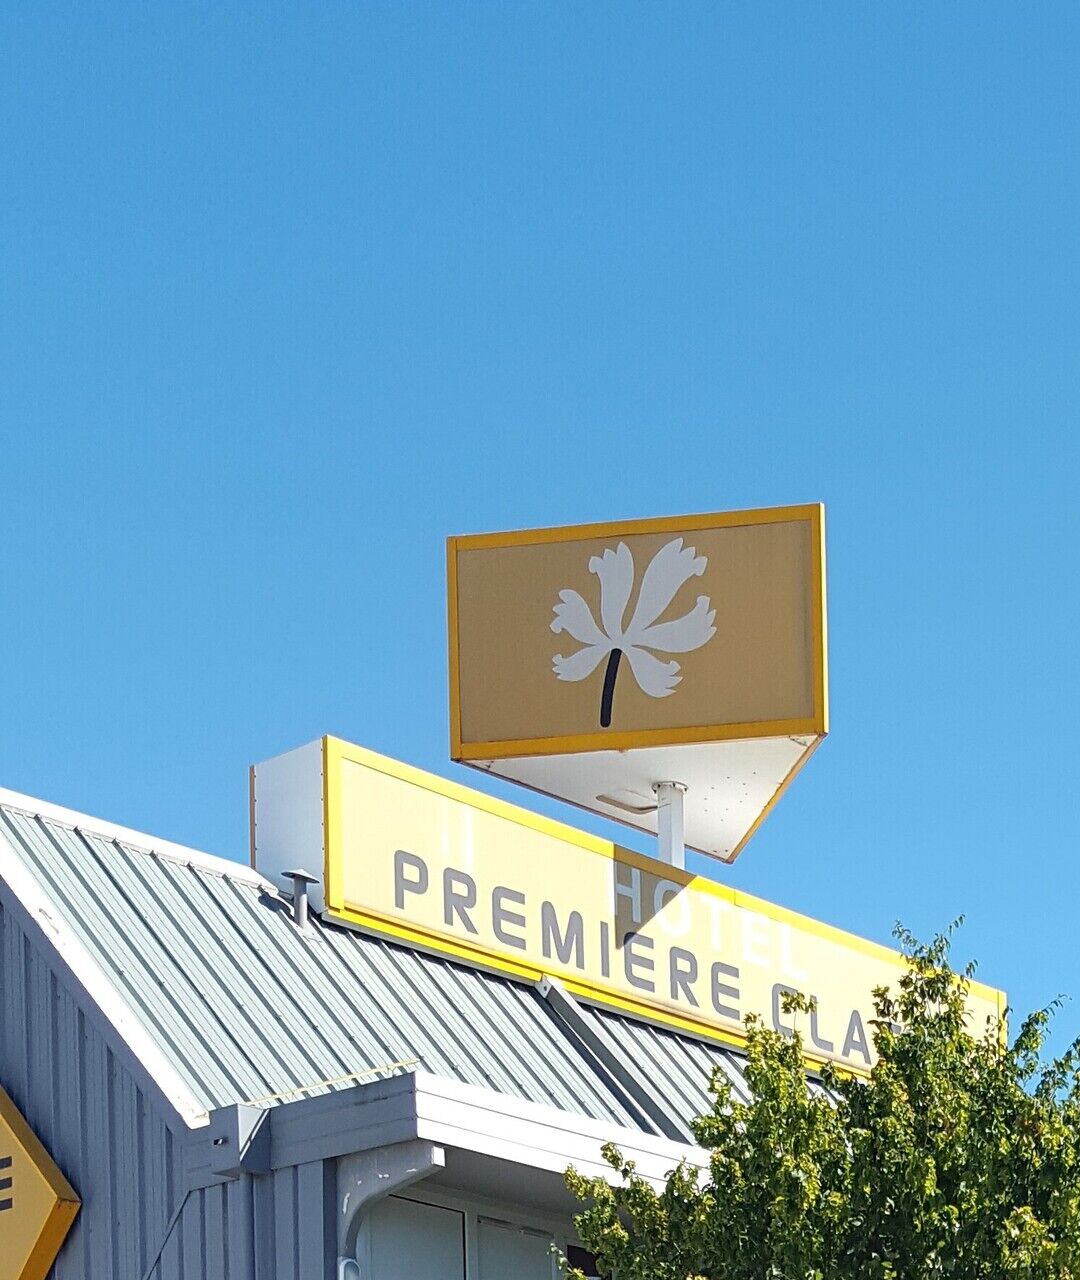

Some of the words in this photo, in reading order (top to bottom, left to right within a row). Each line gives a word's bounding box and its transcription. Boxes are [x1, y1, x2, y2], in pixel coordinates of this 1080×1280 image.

[394, 849, 741, 1020] PREMIERE
[771, 982, 903, 1066] CLA
[613, 861, 808, 982] HOTEL
